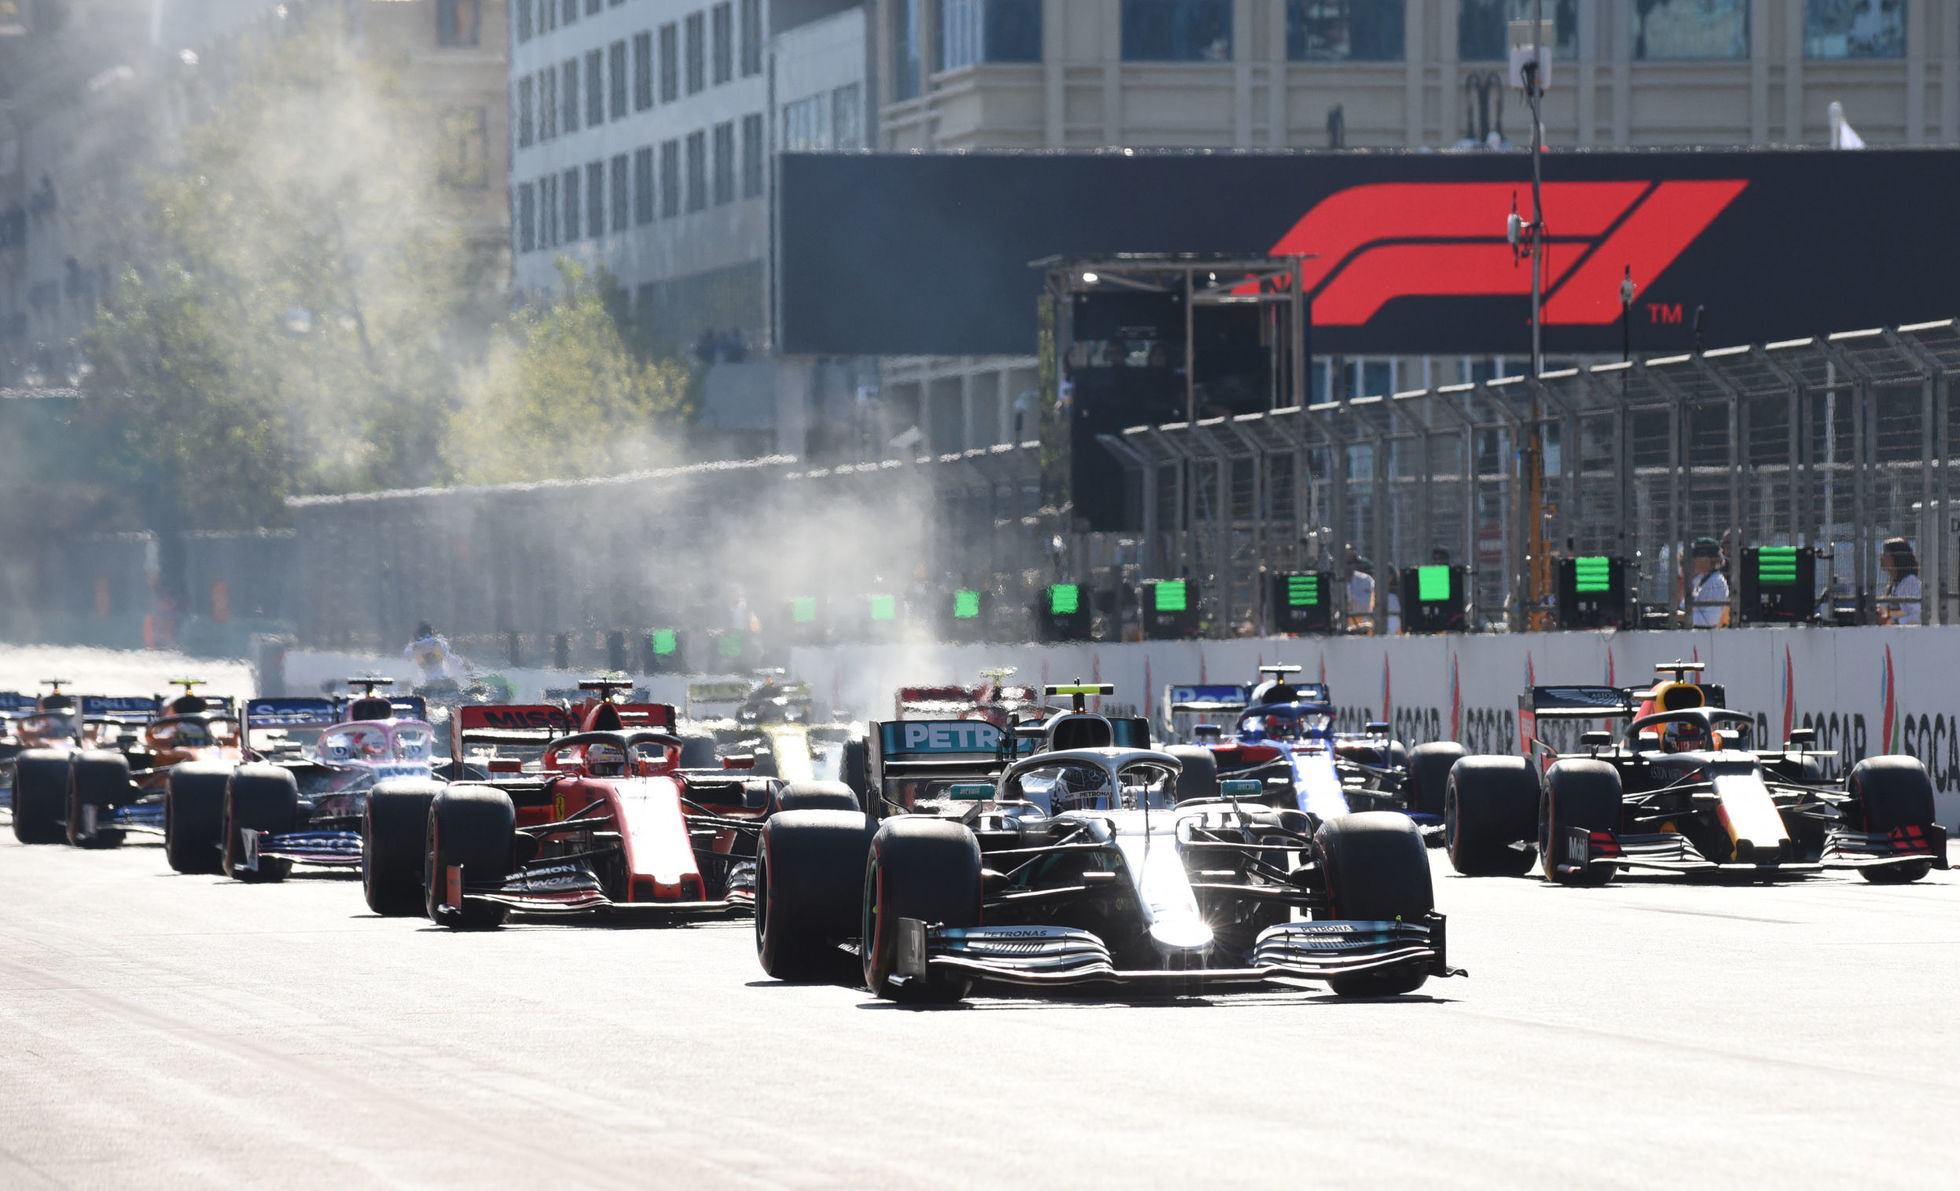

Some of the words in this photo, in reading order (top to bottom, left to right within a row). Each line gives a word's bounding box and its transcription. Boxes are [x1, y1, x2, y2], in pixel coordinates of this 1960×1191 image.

[1646, 303, 1683, 324] TM
[505, 864, 577, 881] MISSION
[984, 930, 1048, 938] PETRONAS
